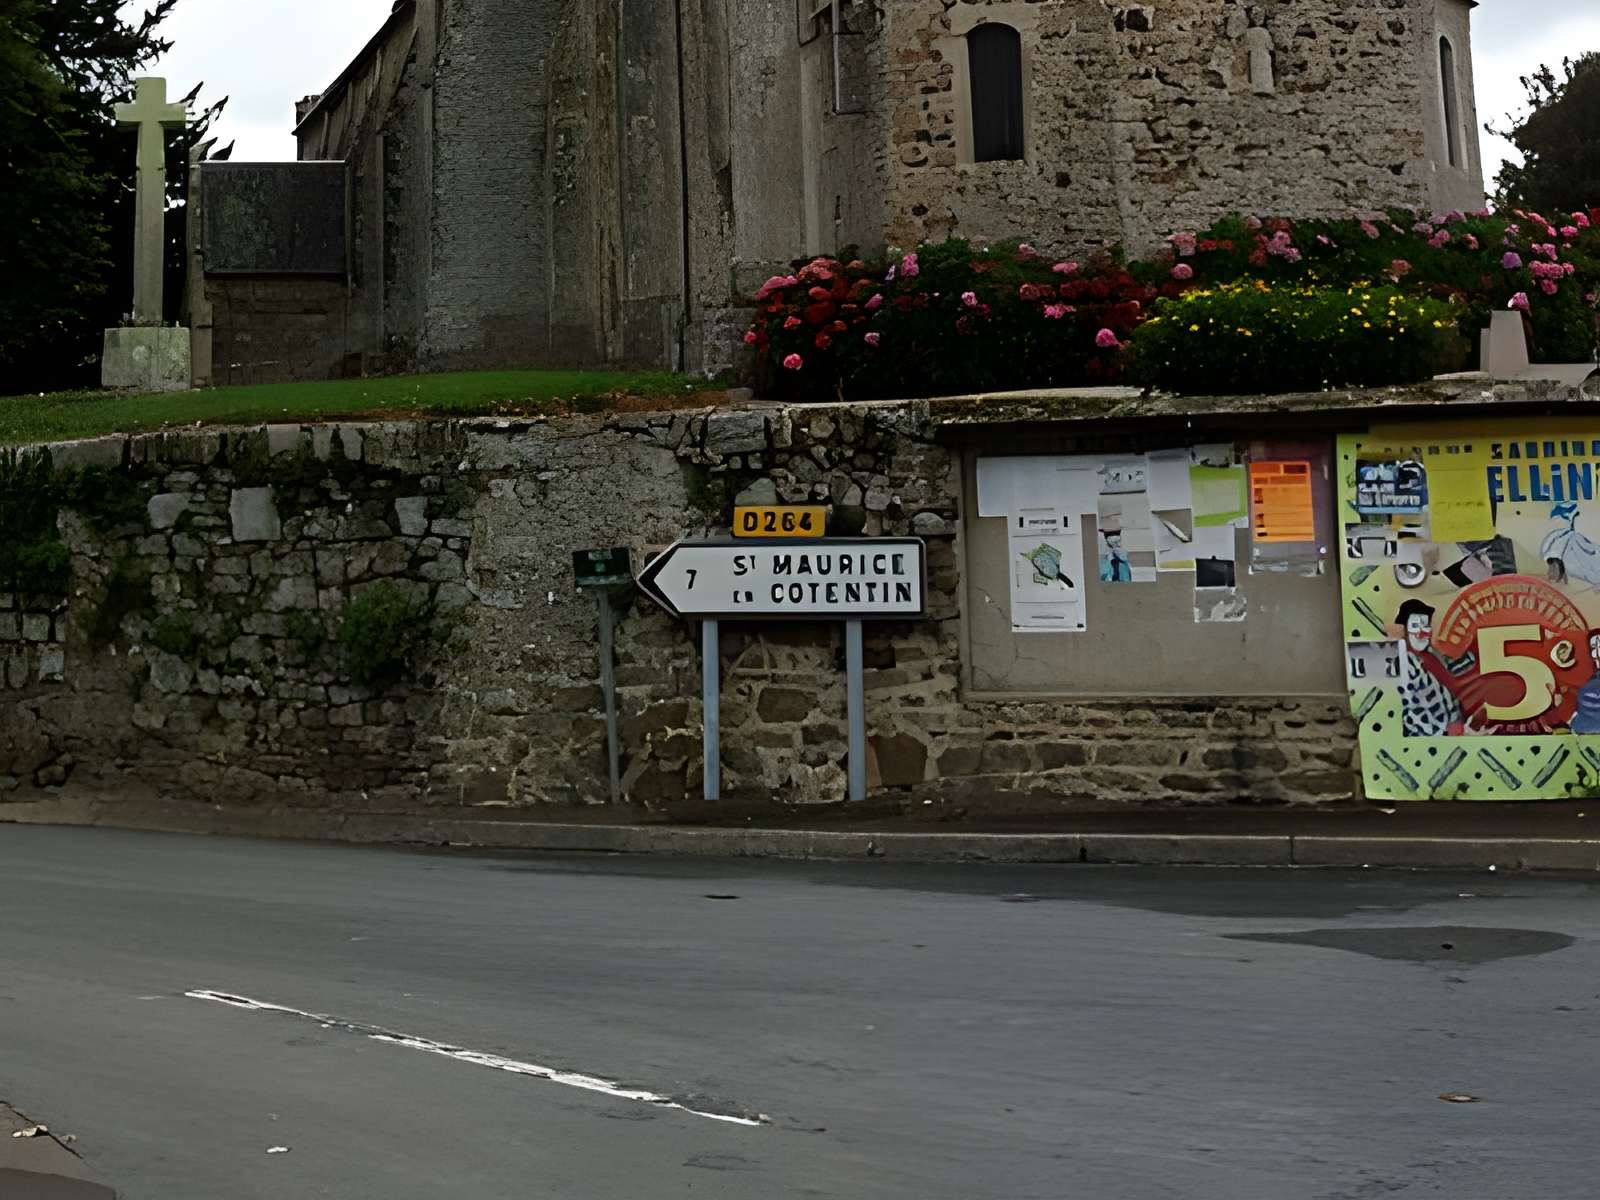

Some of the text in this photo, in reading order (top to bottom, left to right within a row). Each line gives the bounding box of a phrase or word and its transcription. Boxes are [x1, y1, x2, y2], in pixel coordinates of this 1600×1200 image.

[772, 554, 905, 576] MAURICE
[685, 569, 698, 590] 7
[770, 582, 913, 603] COTENTIN
